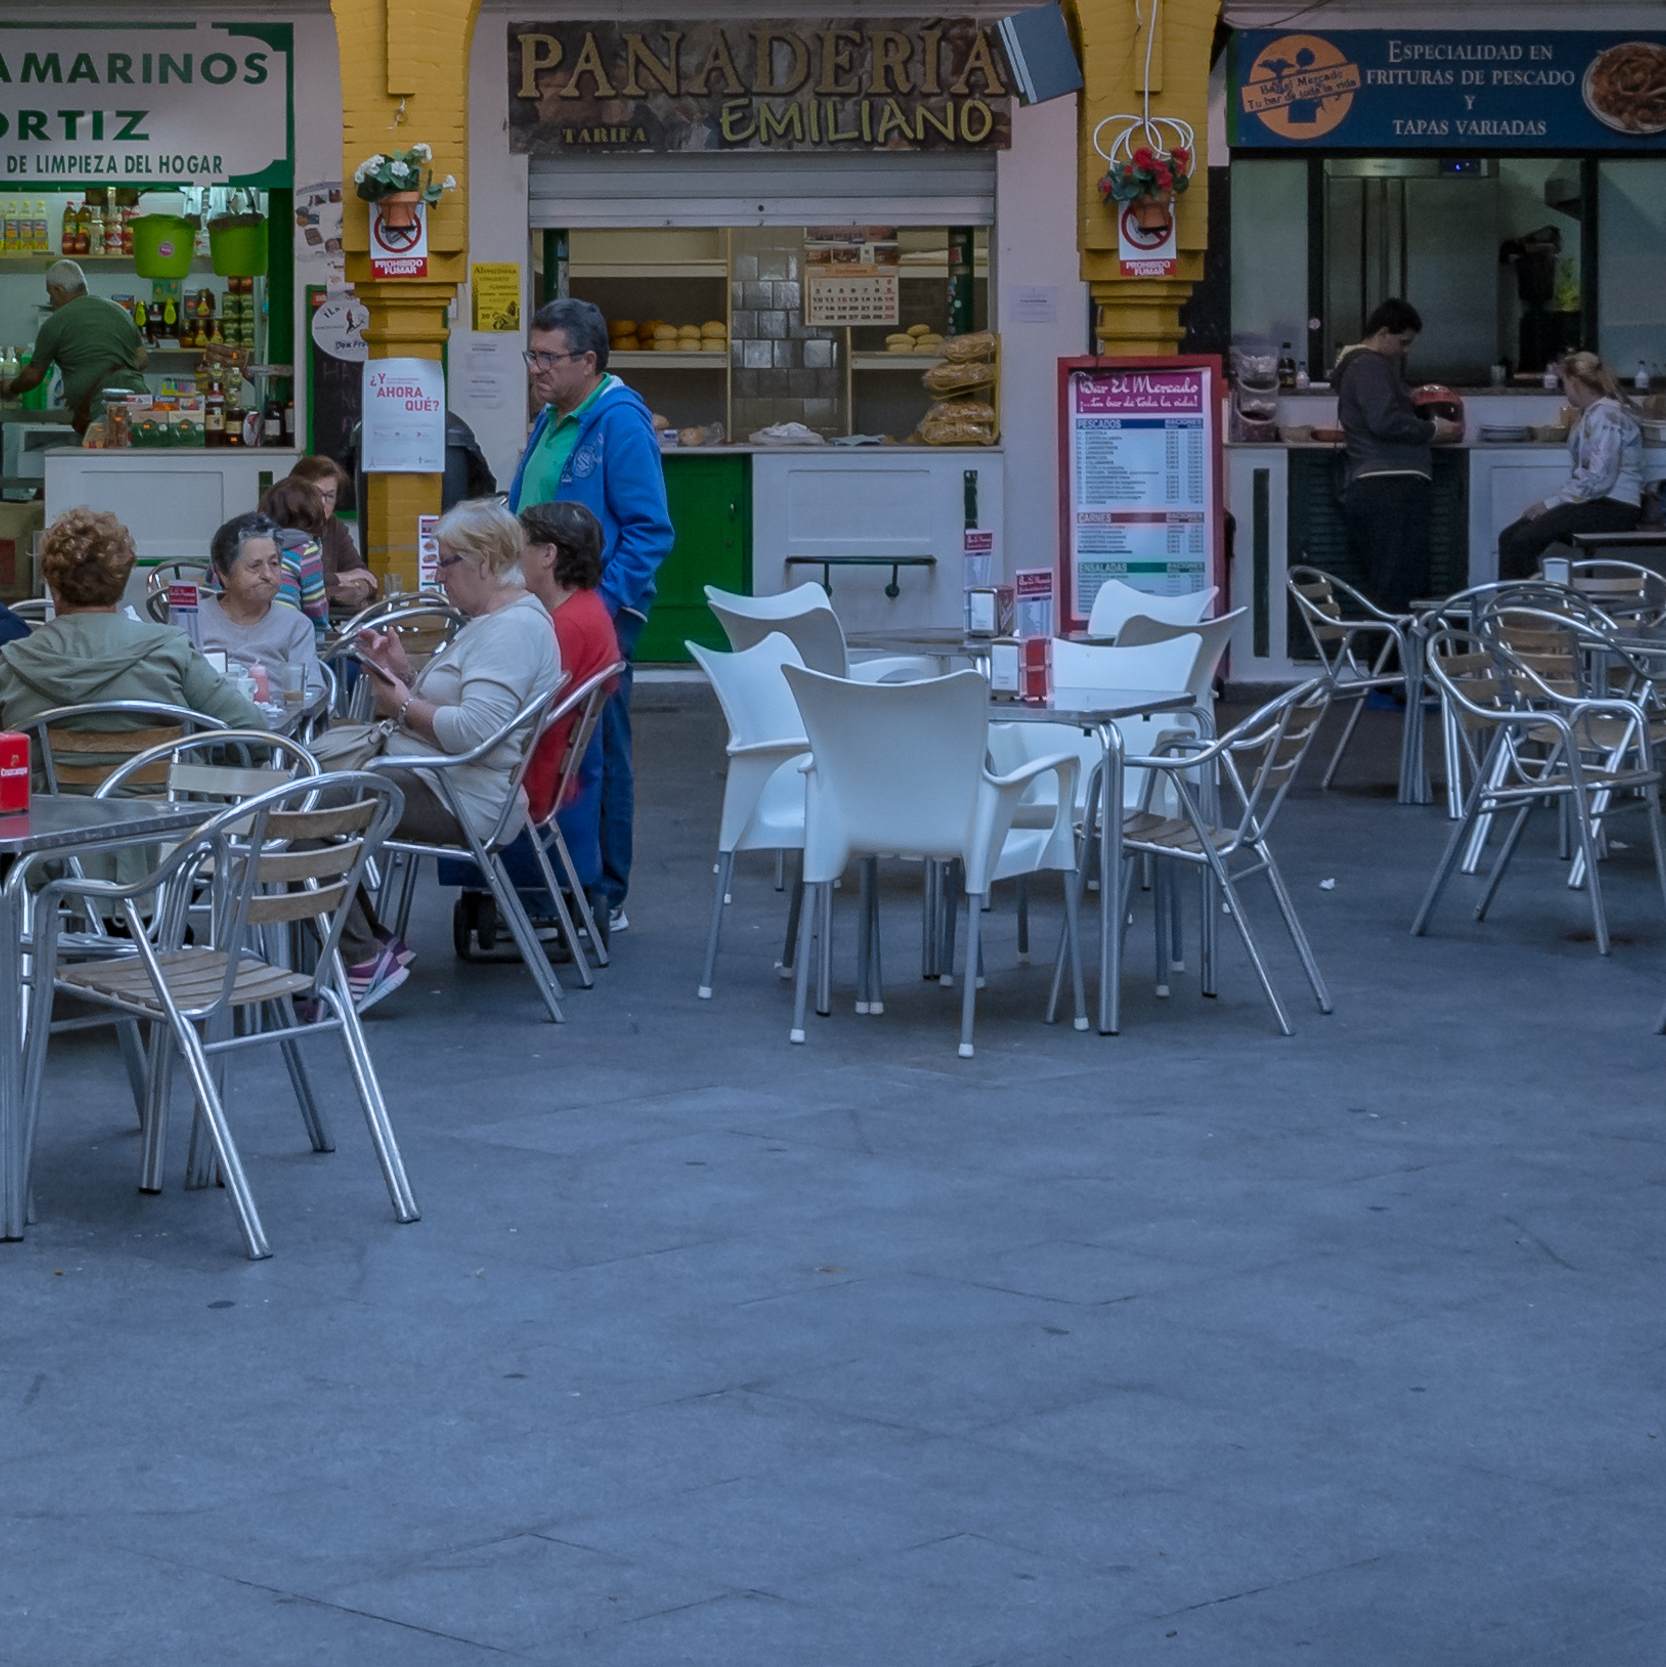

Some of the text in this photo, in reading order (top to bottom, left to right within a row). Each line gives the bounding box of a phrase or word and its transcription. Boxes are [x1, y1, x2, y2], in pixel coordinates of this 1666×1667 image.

[1388, 40, 1554, 63] ESPECIALIDAD EN
[516, 27, 1008, 99] PANADERÍA
[1366, 69, 1576, 87] FRITURAS DE PESCADO
[1464, 94, 1476, 110] Y
[719, 98, 994, 145] EMILIANO
[1392, 119, 1548, 137] TAPAS VARIADAS
[562, 126, 650, 145] TARIFA
[6, 154, 28, 173] DE
[35, 154, 118, 174] LIMPIEZA
[124, 155, 153, 174] DEL
[158, 156, 223, 175] HOGAR
[374, 259, 424, 269] PROHIBIDO
[369, 373, 386, 387] ¿Y
[1111, 378, 1131, 394] El
[1132, 374, 1199, 394] Mercado
[376, 386, 424, 398] AHORA
[404, 396, 440, 412] QUÉ?
[1076, 419, 1122, 429] PESCADOS
[1078, 513, 1112, 523] CARNES
[1079, 563, 1128, 573] ENSALADAS
